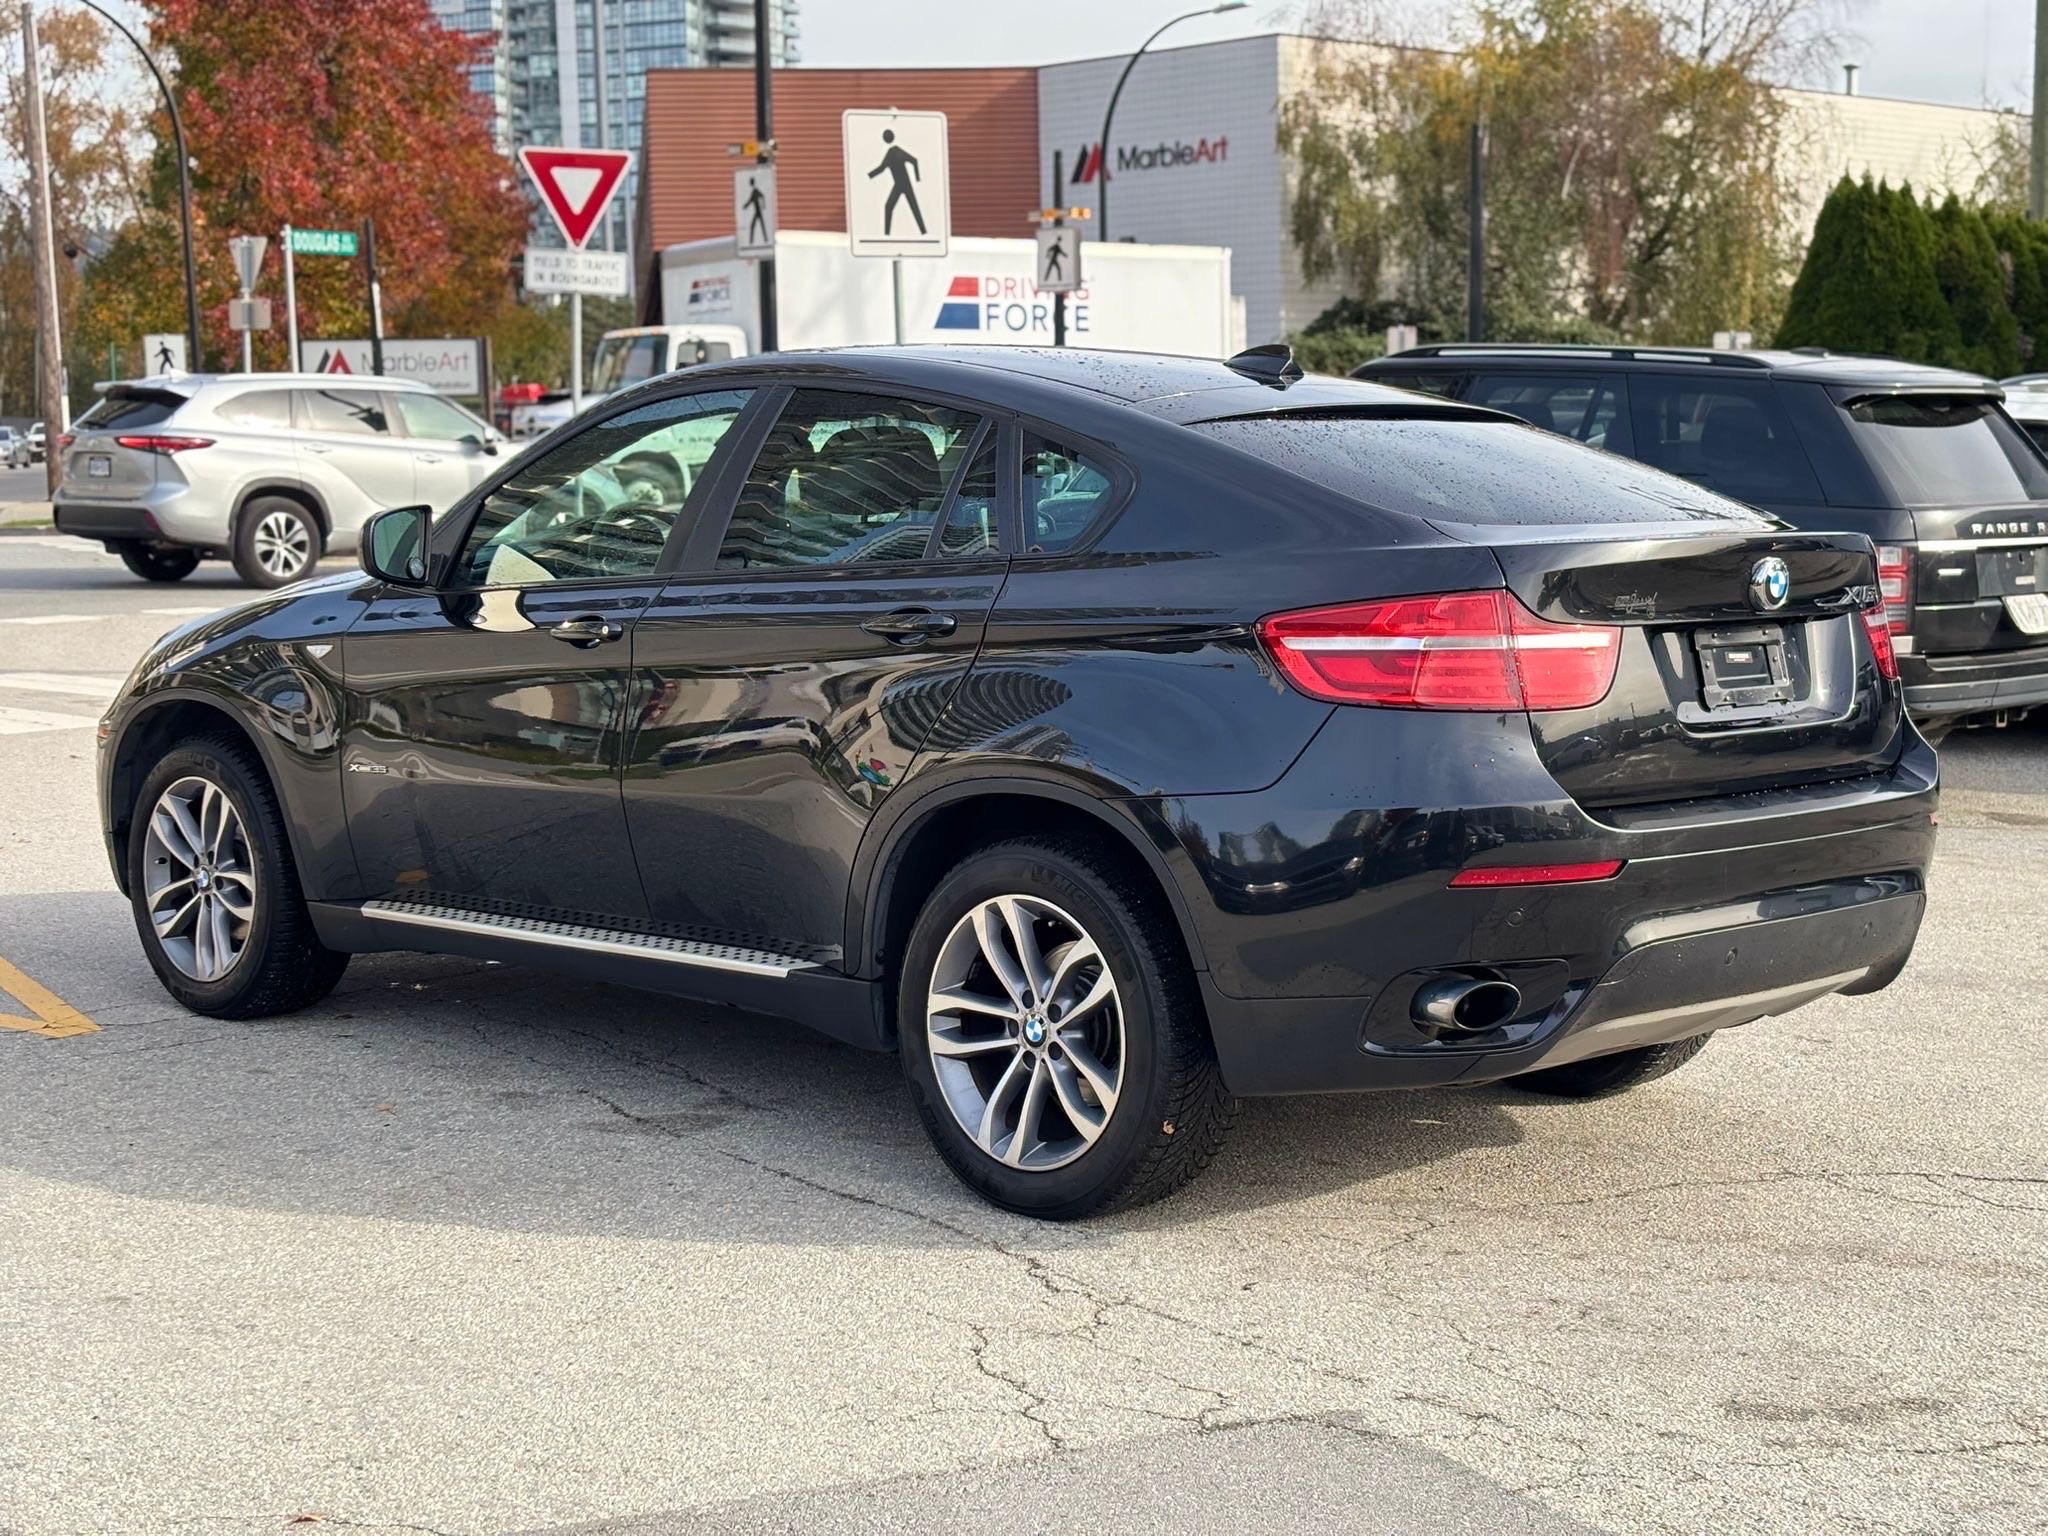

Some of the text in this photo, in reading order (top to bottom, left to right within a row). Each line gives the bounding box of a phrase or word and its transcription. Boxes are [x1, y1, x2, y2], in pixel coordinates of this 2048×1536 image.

[1117, 136, 1228, 171] MarbleArt
[292, 230, 341, 253] DOUGLAS
[985, 277, 1090, 300] DRIVG
[986, 303, 1090, 332] FORE
[1971, 523, 2029, 534] RANGE
